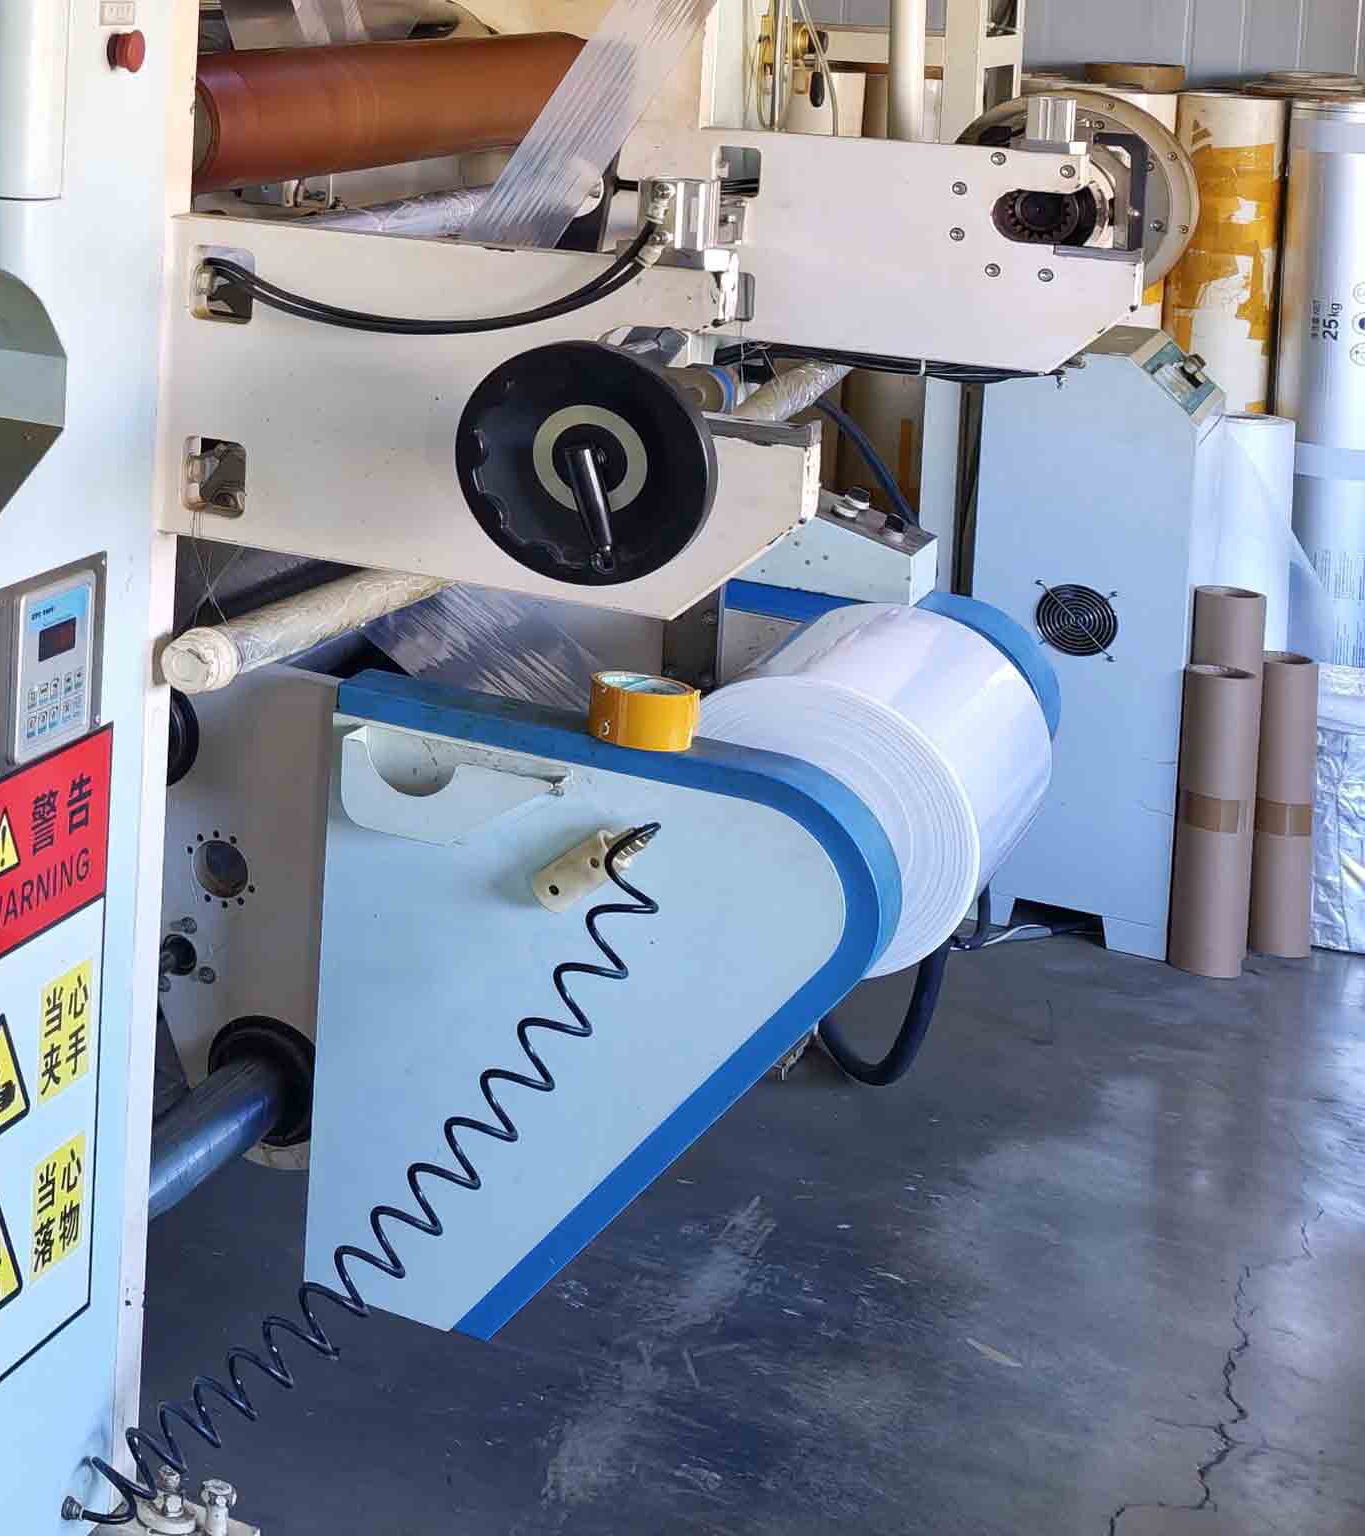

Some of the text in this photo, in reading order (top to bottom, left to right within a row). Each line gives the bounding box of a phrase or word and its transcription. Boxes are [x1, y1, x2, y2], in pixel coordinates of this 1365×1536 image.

[1322, 302, 1343, 341] 25 kg
[31, 772, 93, 856] 警告
[44, 973, 89, 1039] 当心
[41, 1023, 87, 1096] 夹手
[37, 1148, 82, 1215] 当心
[34, 1199, 80, 1273] 落物
